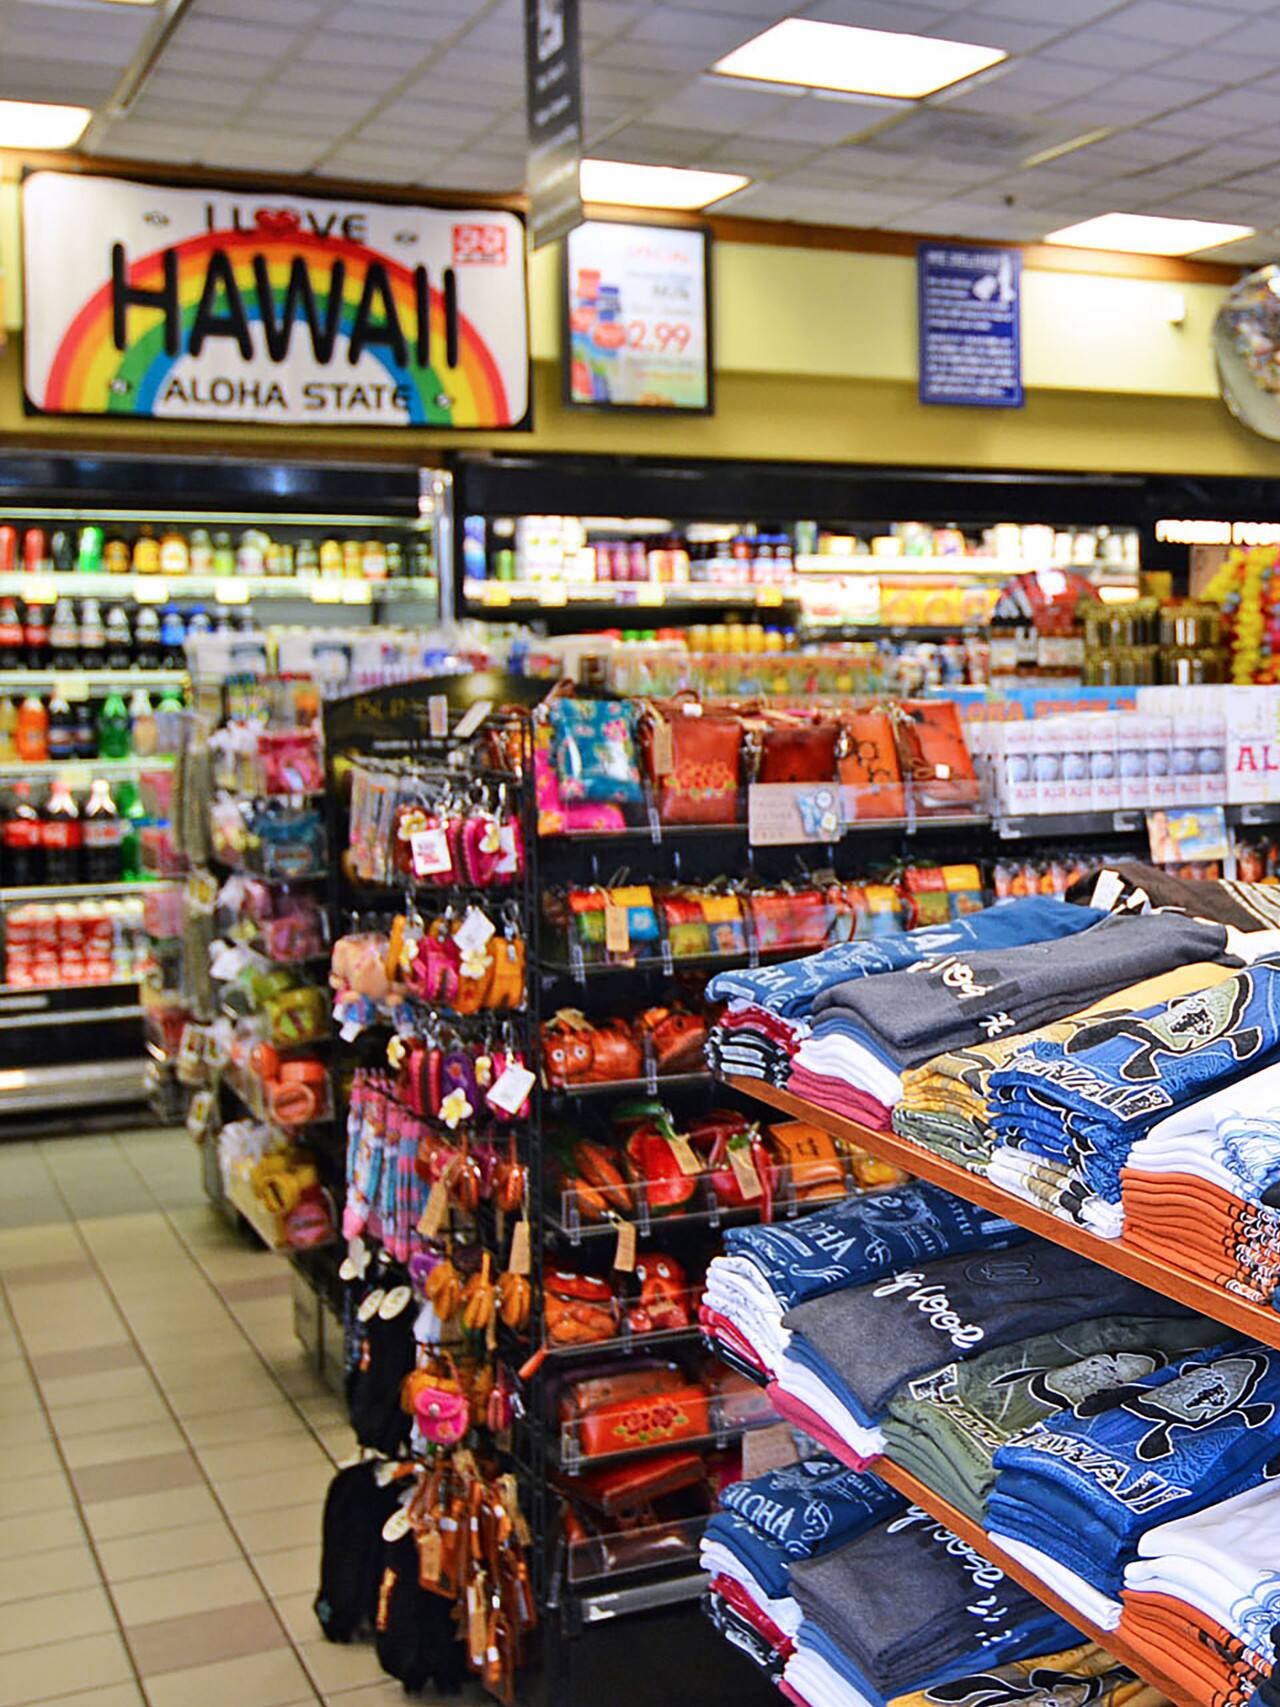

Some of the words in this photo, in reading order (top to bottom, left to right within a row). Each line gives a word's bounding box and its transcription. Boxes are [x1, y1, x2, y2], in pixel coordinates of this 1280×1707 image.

[112, 242, 459, 370] HAWAII
[628, 319, 692, 353] 2.99
[164, 376, 289, 410] ALOHA
[303, 383, 412, 413] STATE
